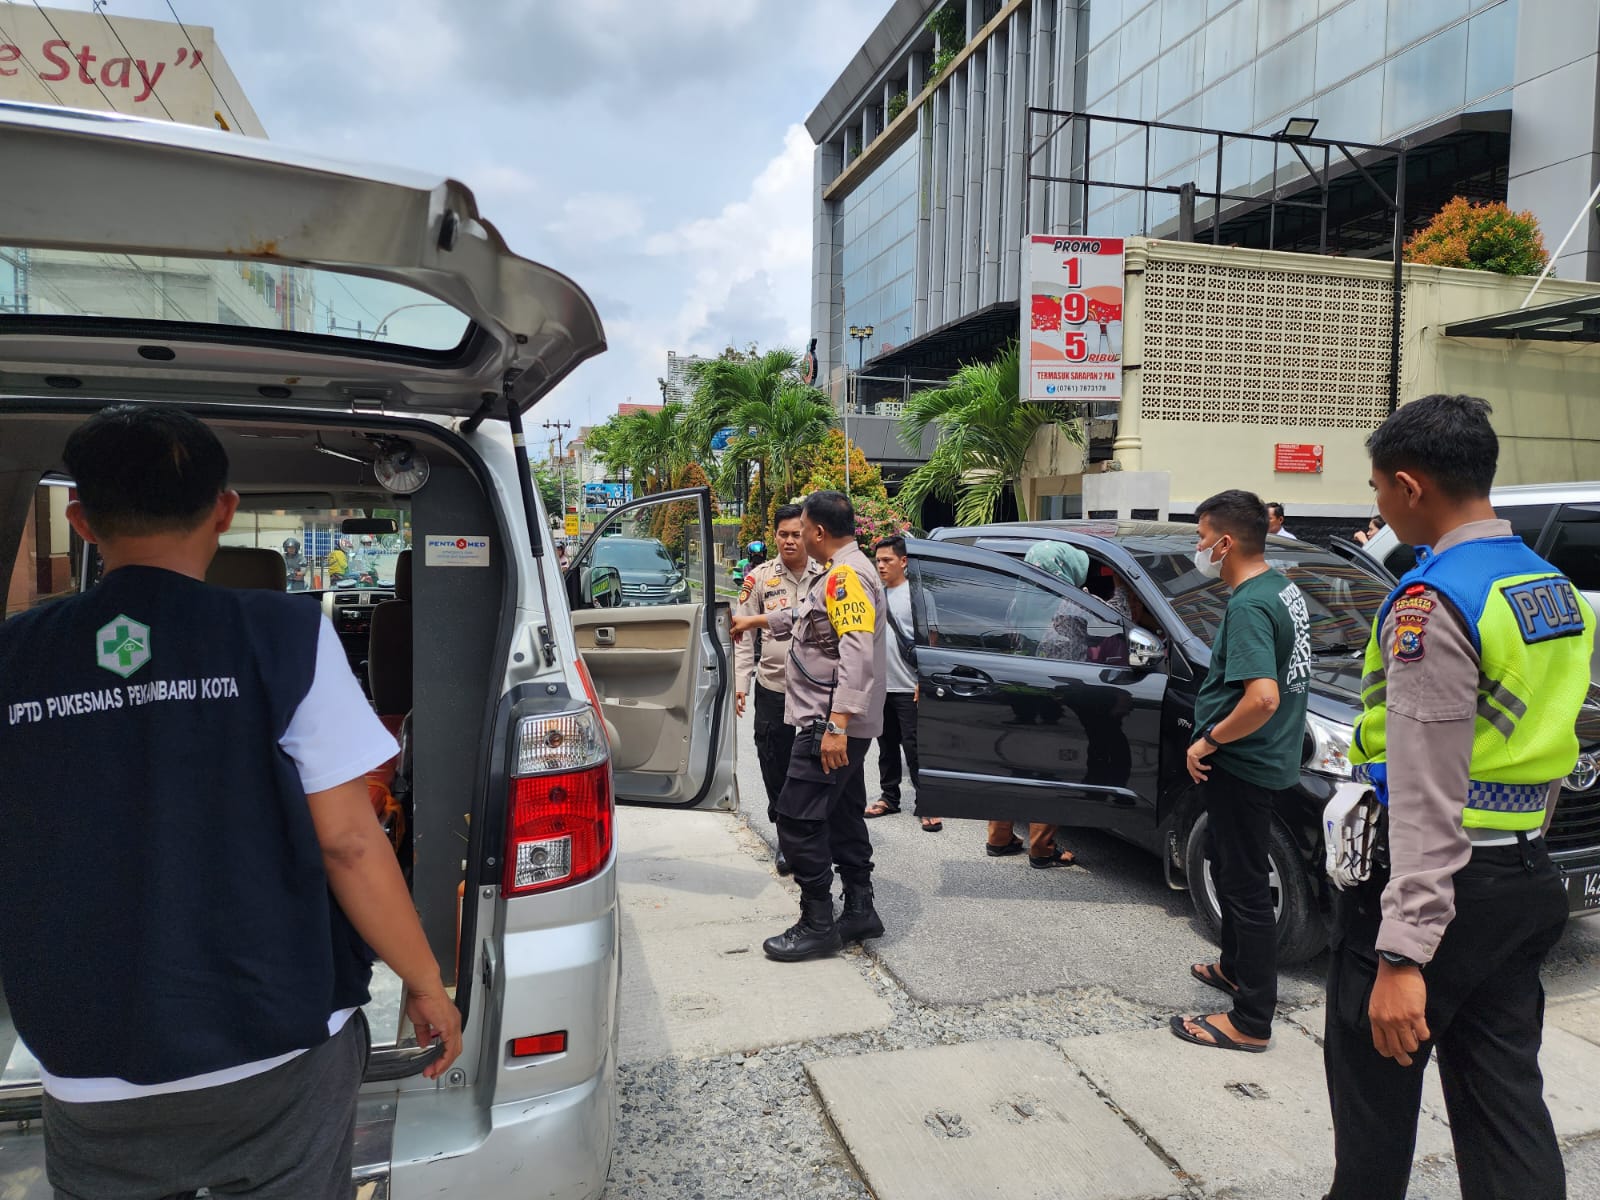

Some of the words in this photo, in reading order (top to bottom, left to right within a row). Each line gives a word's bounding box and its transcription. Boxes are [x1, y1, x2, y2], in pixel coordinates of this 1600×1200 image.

[1053, 240, 1101, 253] PROMO
[1037, 371, 1070, 380] TERMASUK
[1071, 371, 1098, 380] SARAPAN
[8, 701, 43, 725] UPTD
[46, 687, 123, 719] PUKESMAS
[201, 677, 239, 699] KOTA
